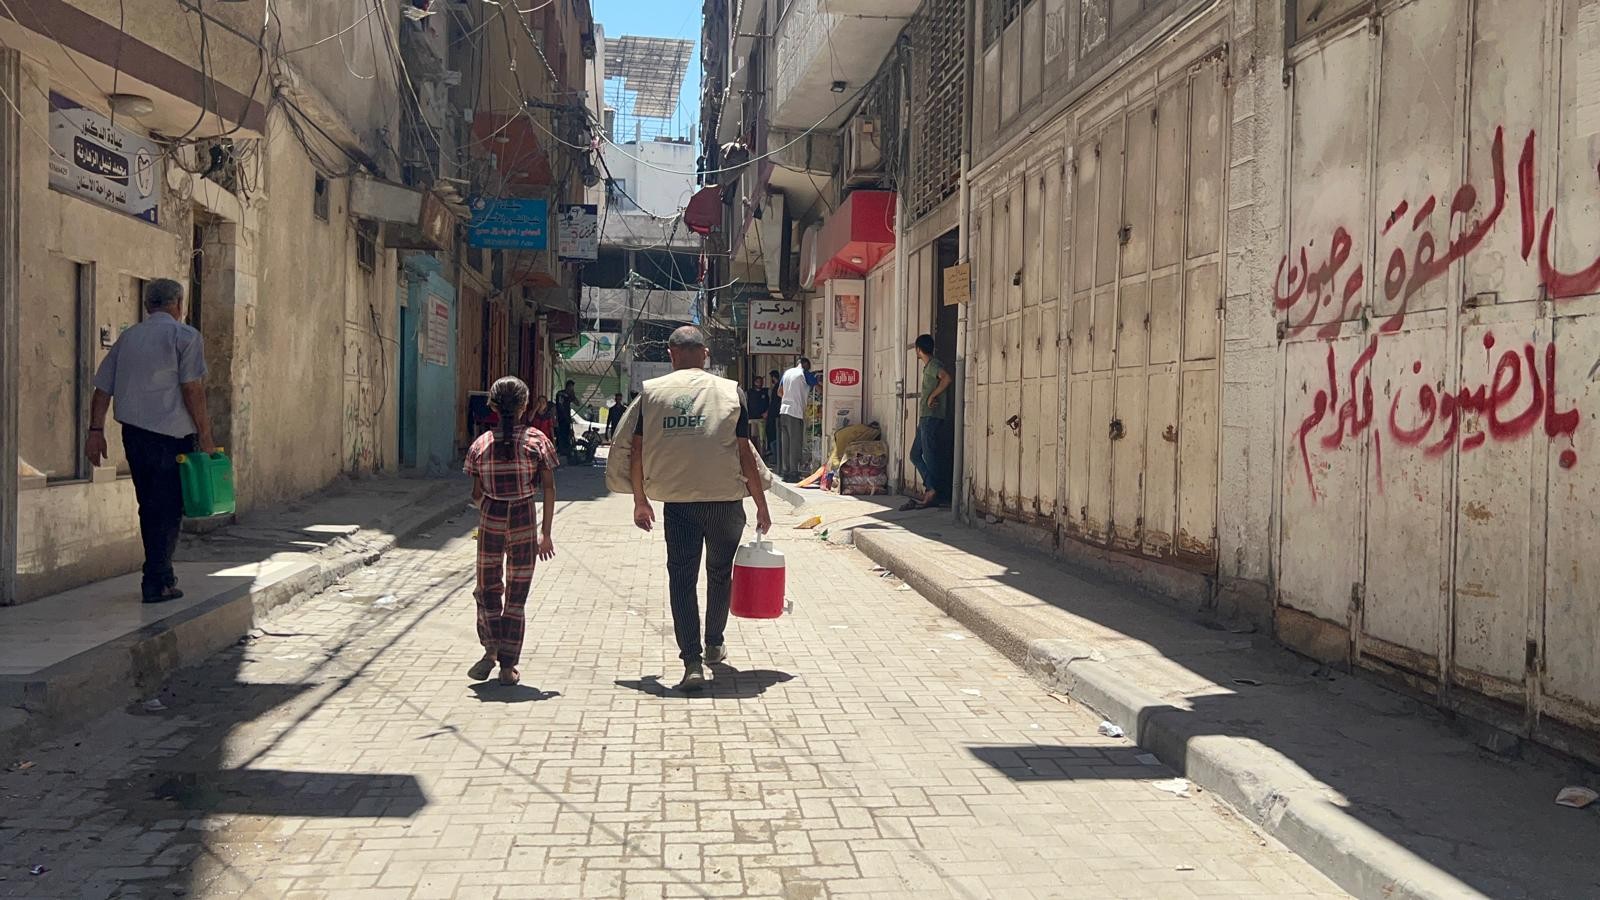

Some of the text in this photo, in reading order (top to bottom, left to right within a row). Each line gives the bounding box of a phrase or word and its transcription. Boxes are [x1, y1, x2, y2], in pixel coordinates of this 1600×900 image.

[757, 303, 794, 315] مركز
[753, 320, 801, 333] بانوراما
[1387, 330, 1581, 471] بالضيوف
